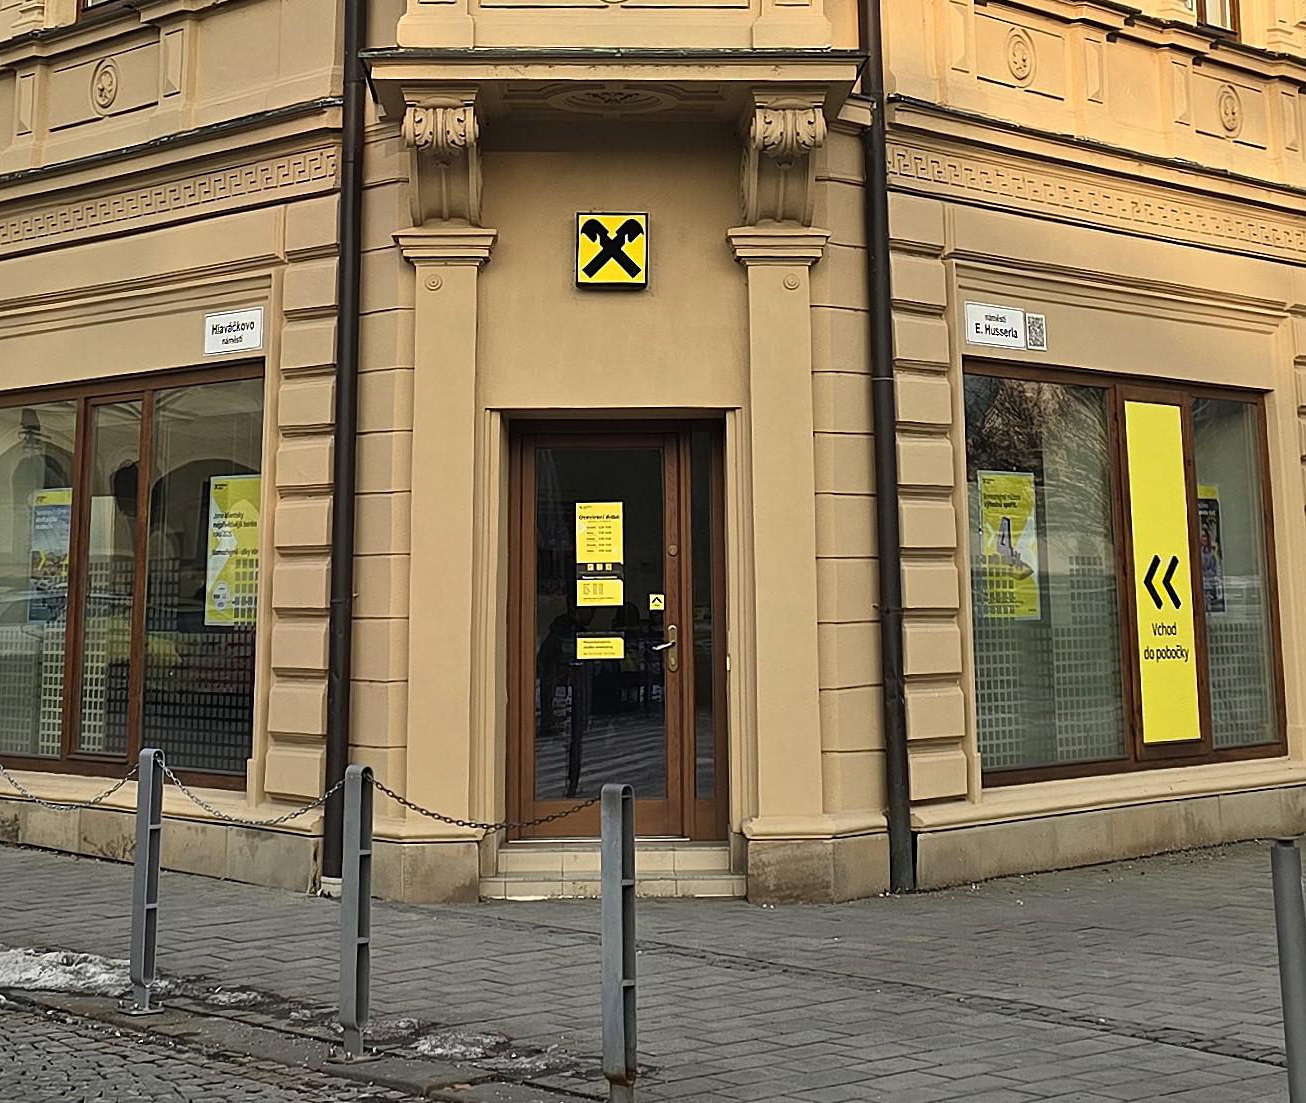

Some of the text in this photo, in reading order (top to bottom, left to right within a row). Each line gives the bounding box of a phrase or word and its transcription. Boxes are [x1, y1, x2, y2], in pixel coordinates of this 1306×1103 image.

[212, 321, 254, 335] Hlaváčkovo
[975, 323, 1018, 338] E. Husserla
[1152, 622, 1177, 636] Vchod
[1144, 645, 1189, 663] do pobočky
